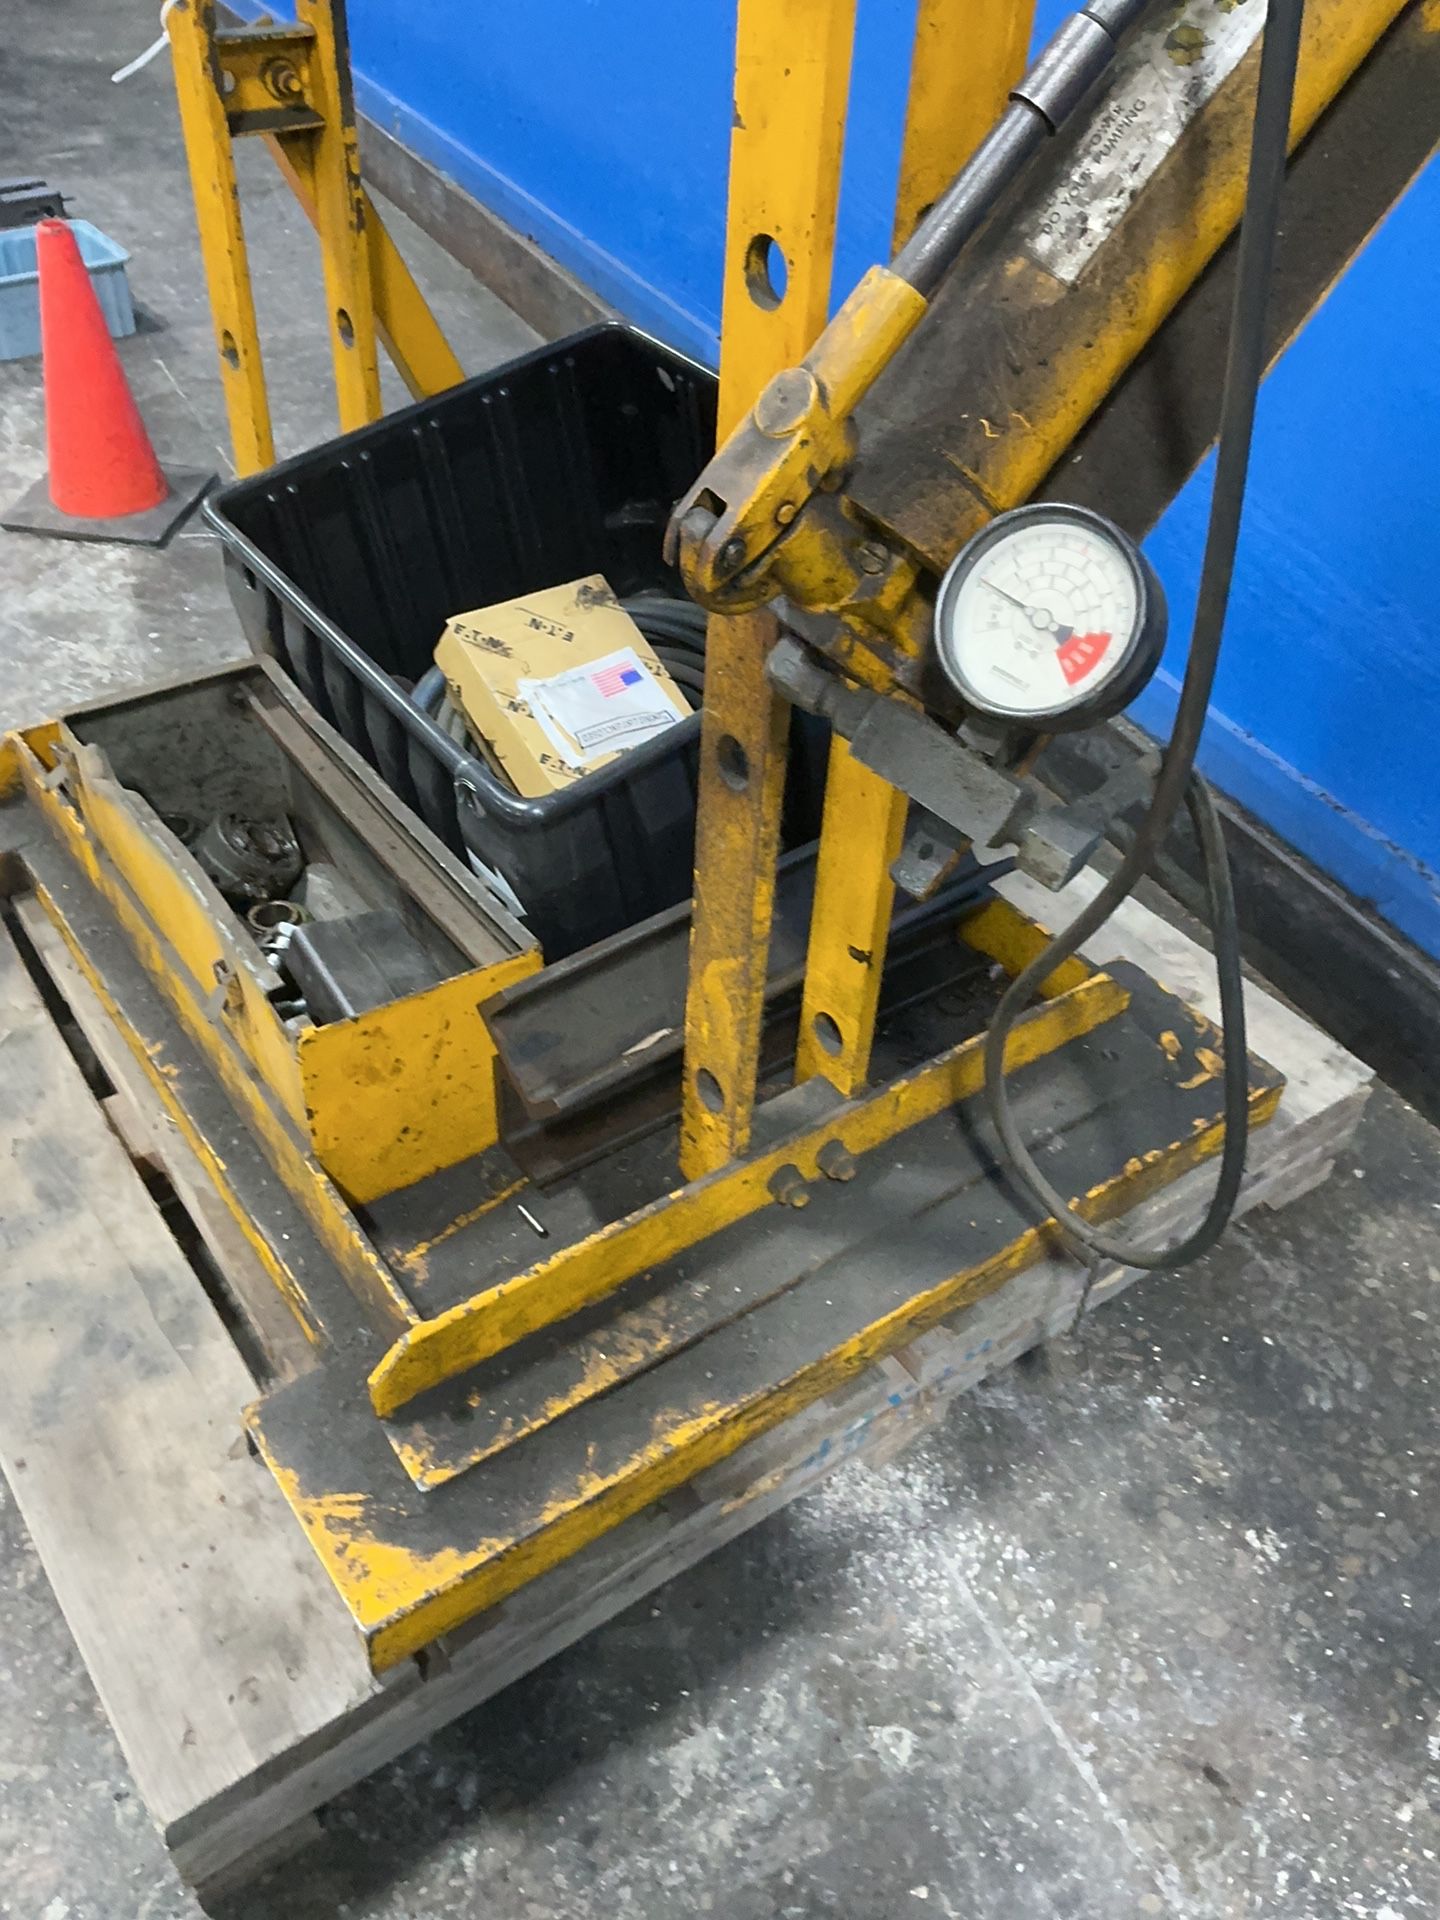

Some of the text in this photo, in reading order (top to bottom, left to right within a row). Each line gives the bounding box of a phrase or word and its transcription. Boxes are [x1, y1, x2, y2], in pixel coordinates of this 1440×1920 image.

[1040, 211, 1061, 235] DO
[1060, 168, 1093, 207] YOUR
[1092, 98, 1147, 165] PUMPING
